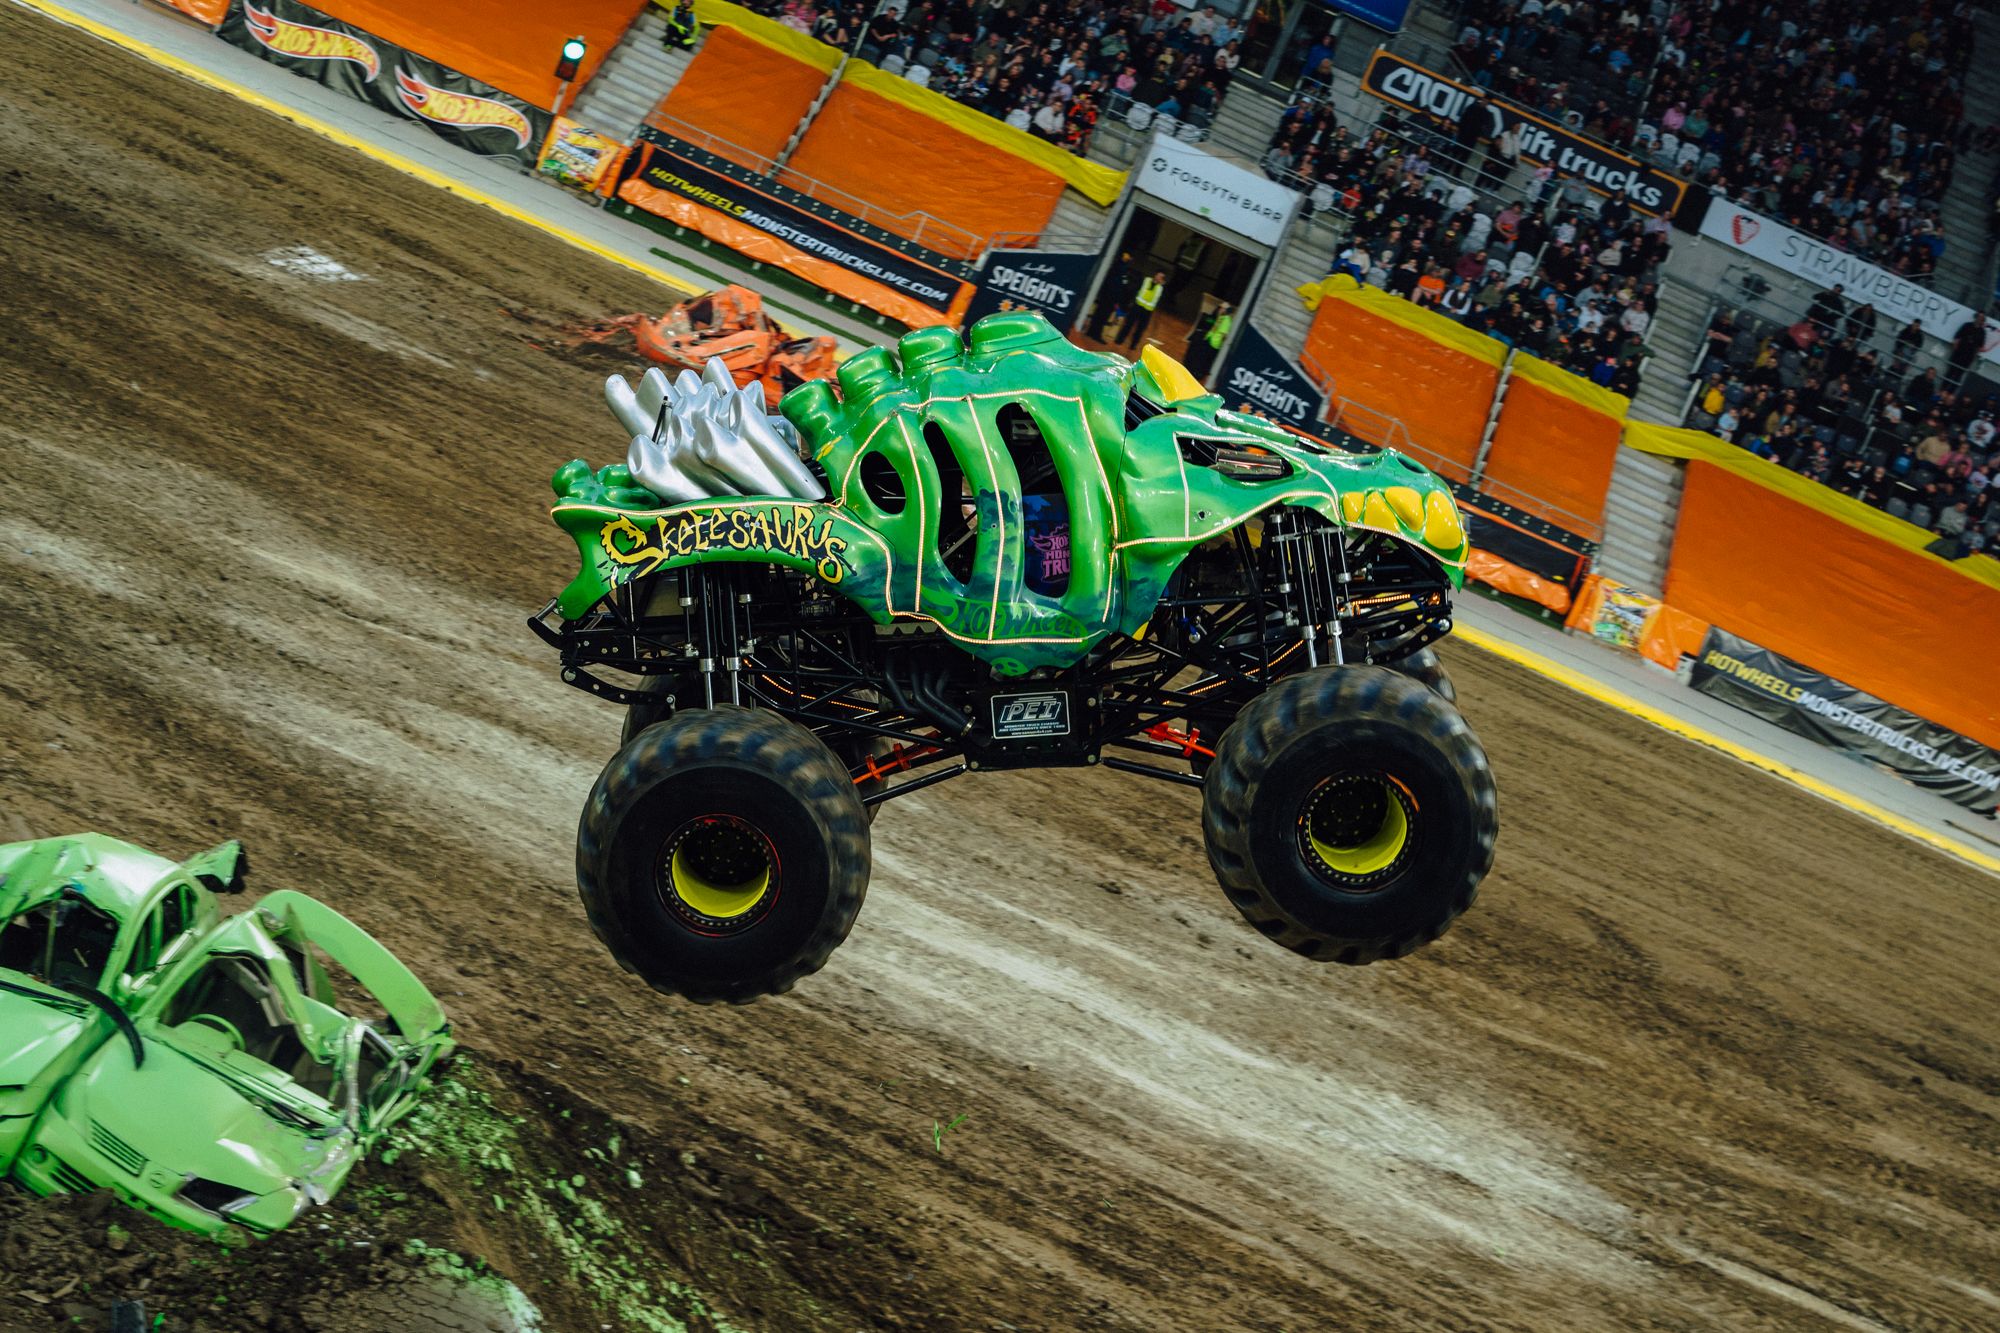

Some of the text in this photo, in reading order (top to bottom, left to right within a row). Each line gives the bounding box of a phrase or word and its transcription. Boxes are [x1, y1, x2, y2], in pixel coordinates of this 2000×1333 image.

[1170, 166, 1284, 224] FORSYTH BARR
[1518, 122, 1557, 161] lift
[1557, 147, 1664, 207] trucks
[1781, 234, 1964, 326] STRAWBERRY
[1006, 700, 1058, 721] PEI
